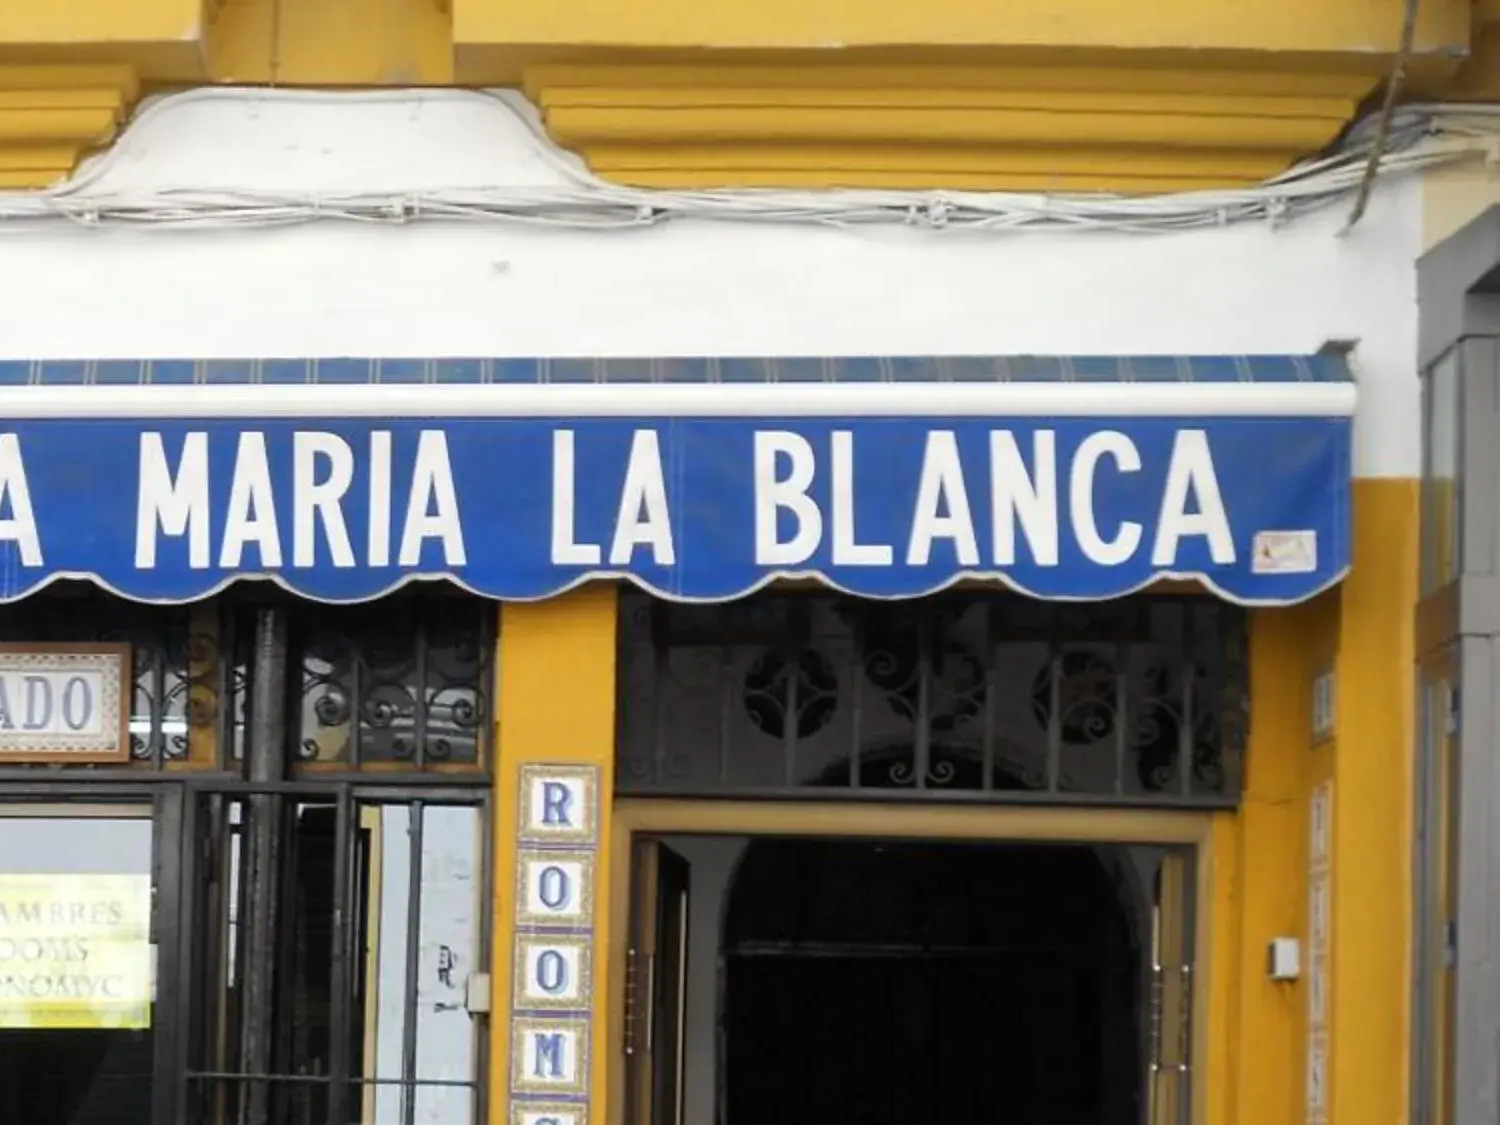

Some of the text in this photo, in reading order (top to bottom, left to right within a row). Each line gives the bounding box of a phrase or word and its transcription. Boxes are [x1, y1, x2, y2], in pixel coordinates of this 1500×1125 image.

[135, 430, 466, 568] MARIA
[551, 429, 675, 565] LA
[754, 429, 1236, 566] BLANCA
